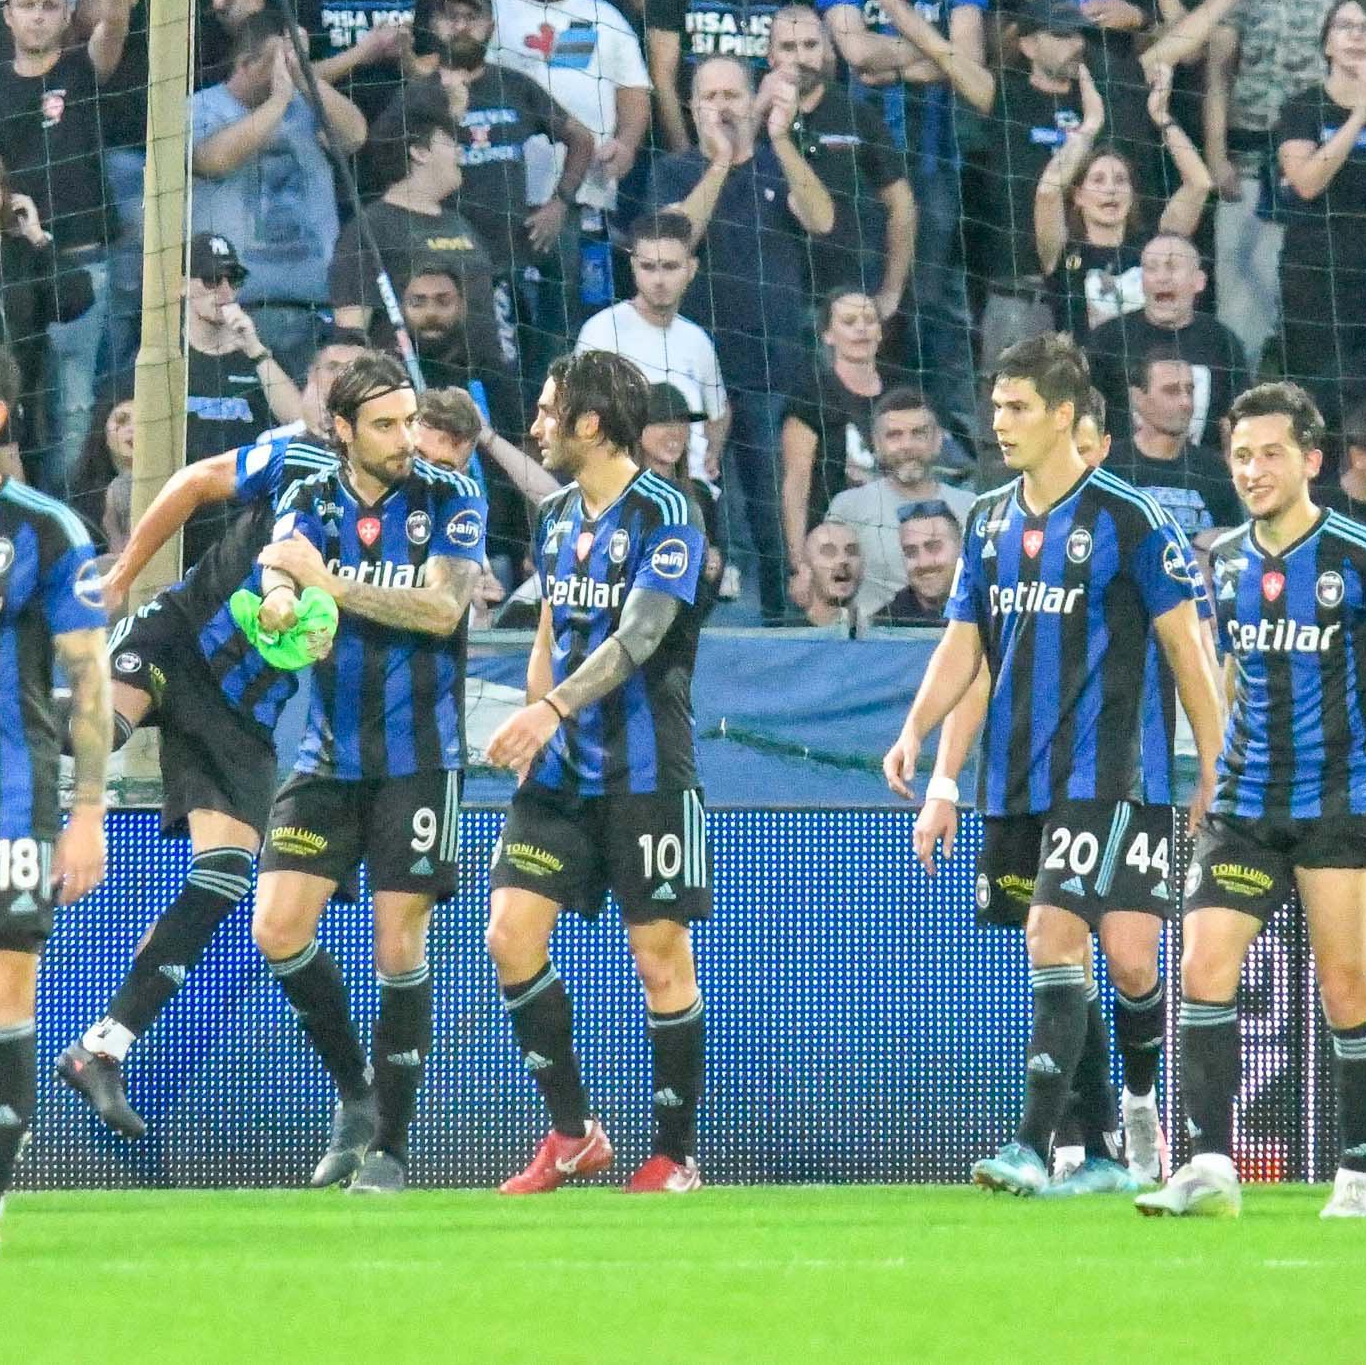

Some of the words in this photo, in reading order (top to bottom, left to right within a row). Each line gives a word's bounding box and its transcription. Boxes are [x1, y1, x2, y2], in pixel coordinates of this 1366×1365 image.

[546, 573, 626, 609] Cetilar
[988, 581, 1085, 616] Cetilar
[1226, 618, 1341, 653] Cetilar
[410, 806, 436, 853] 9
[638, 833, 682, 879] 10
[1044, 827, 1099, 875] 20
[1126, 832, 1170, 879] 44
[1211, 863, 1243, 877] TONI
